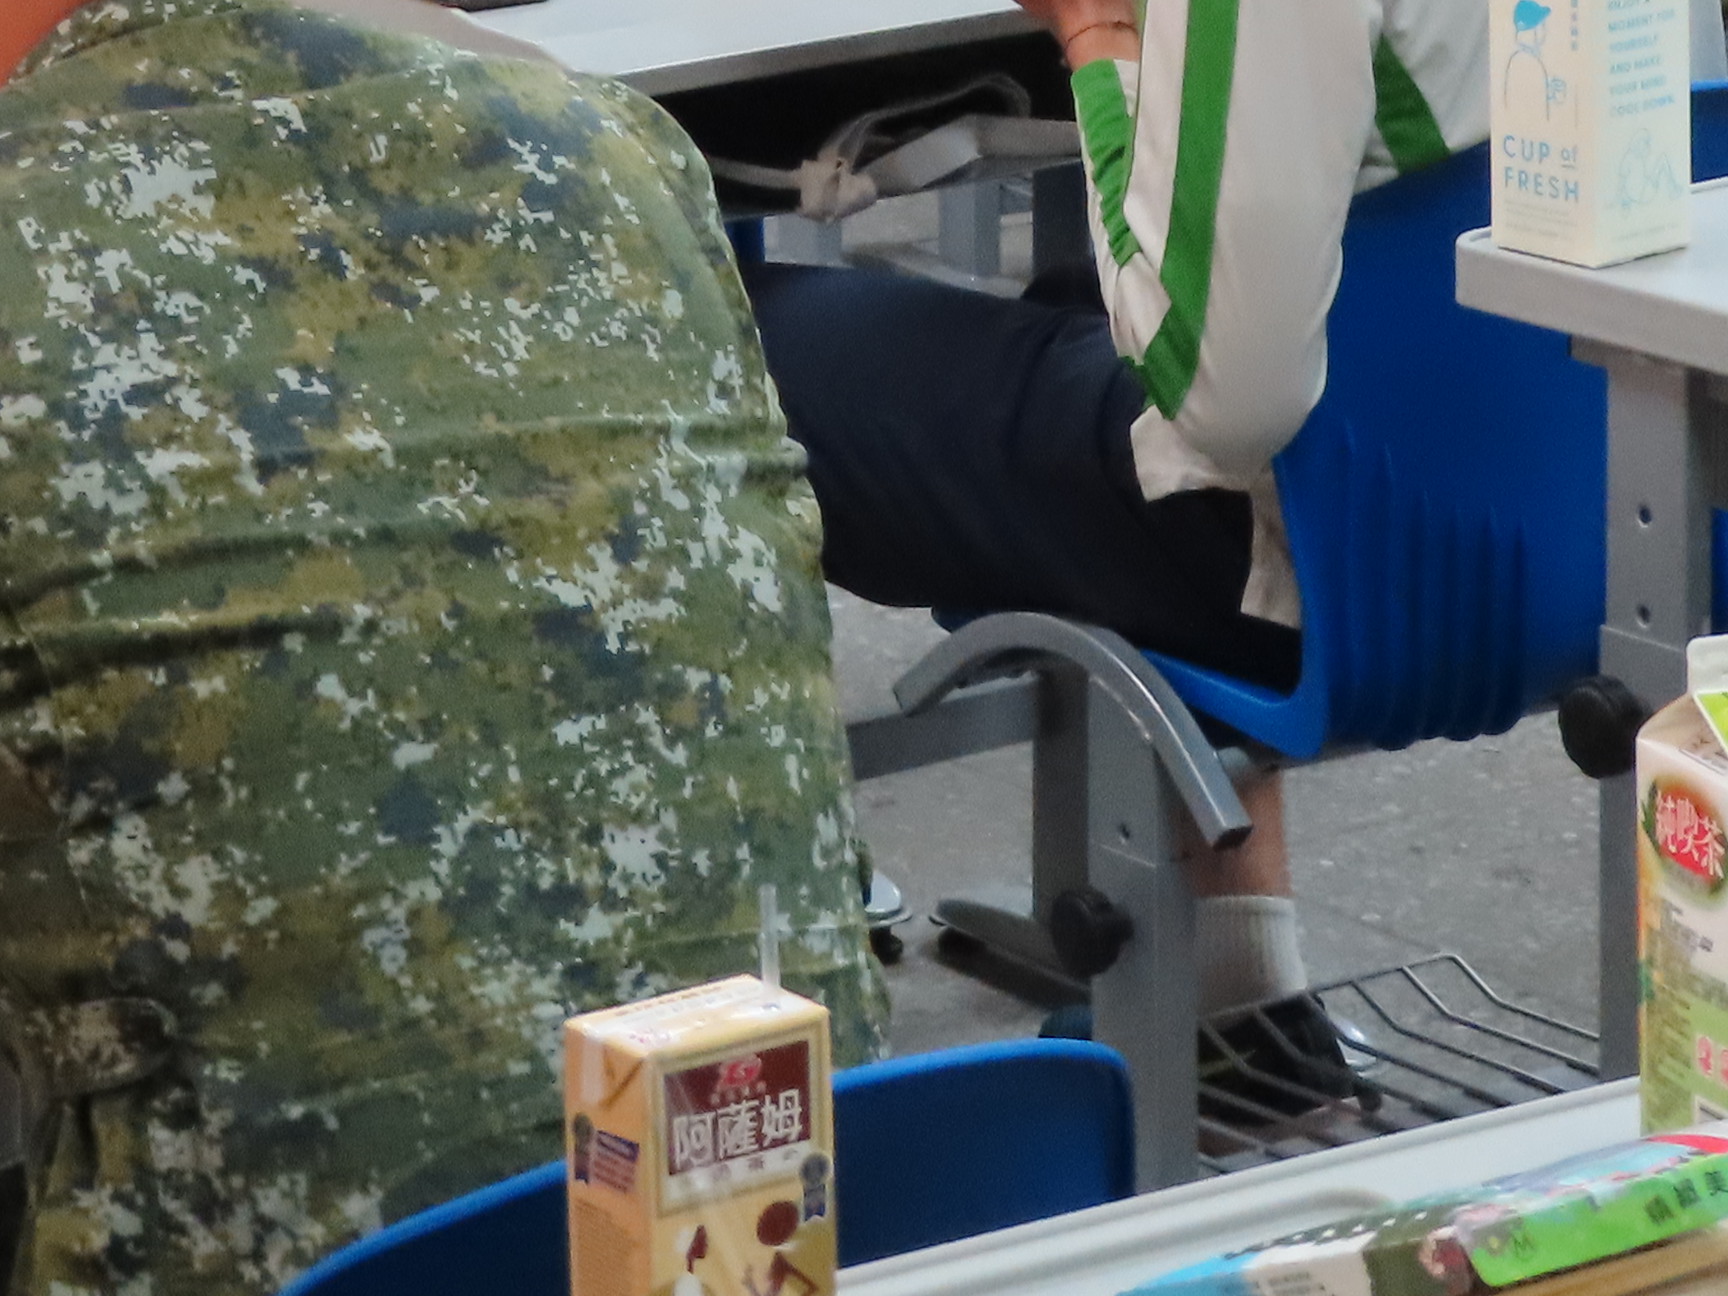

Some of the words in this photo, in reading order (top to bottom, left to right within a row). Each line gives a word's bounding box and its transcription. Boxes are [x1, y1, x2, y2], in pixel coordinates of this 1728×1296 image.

[1503, 135, 1551, 165] CUP
[1503, 166, 1580, 204] FRESH
[1655, 790, 1727, 880] 純喫茶
[671, 1088, 803, 1172] 阿薩姆
